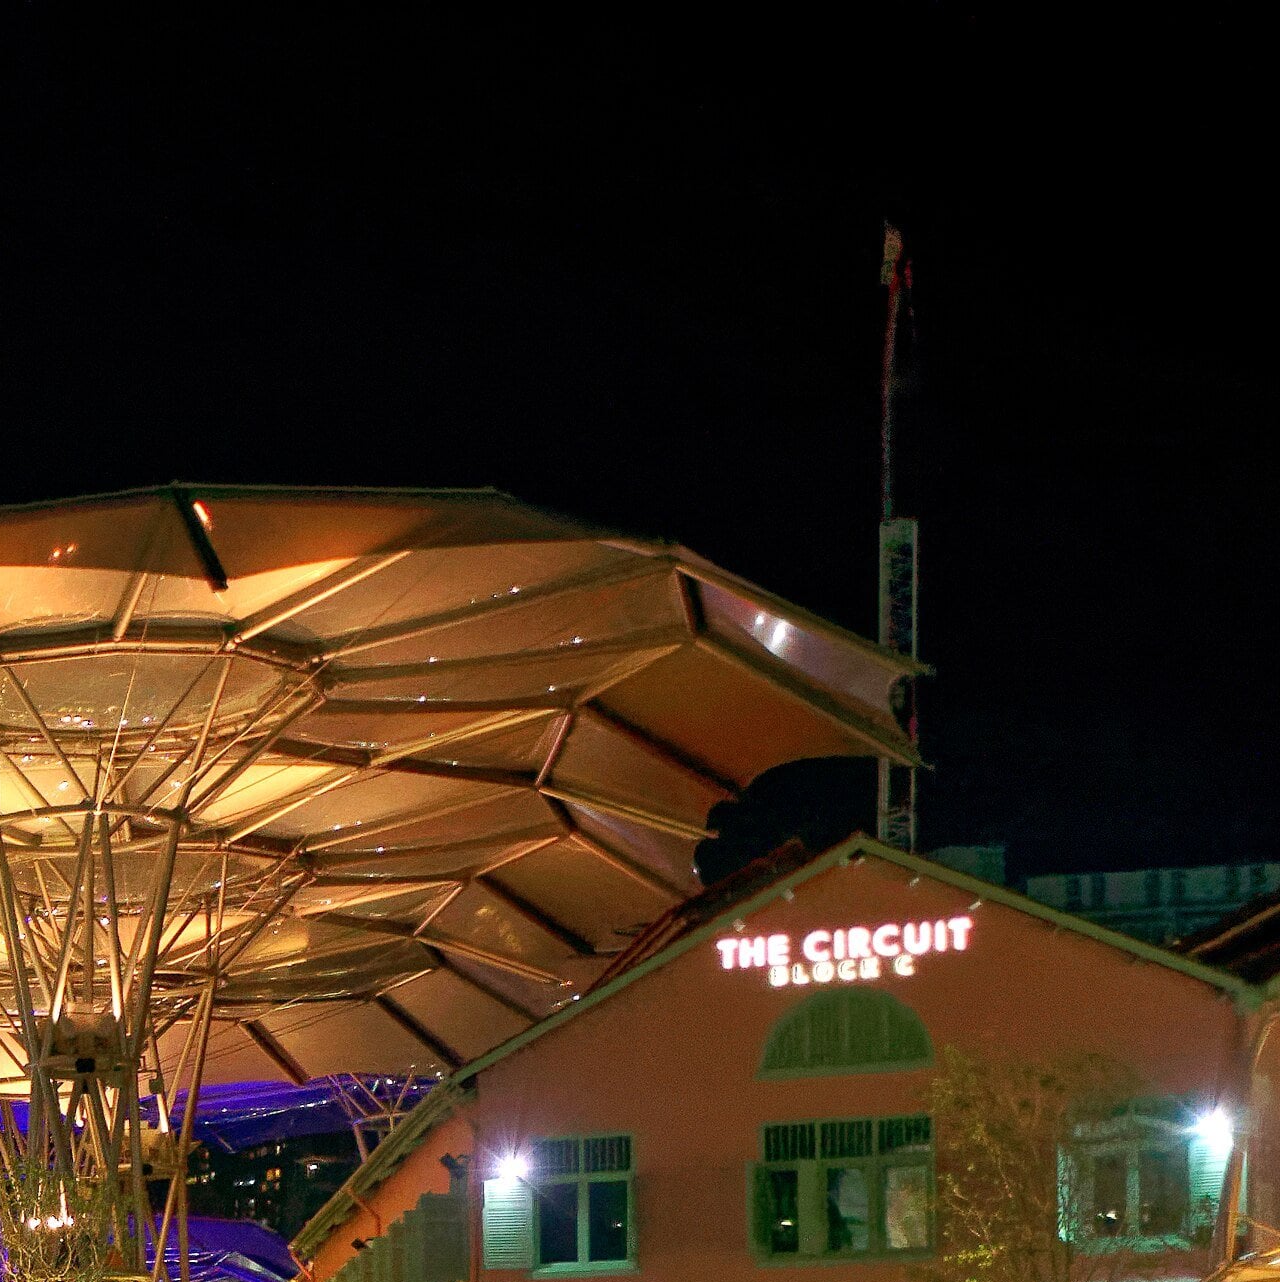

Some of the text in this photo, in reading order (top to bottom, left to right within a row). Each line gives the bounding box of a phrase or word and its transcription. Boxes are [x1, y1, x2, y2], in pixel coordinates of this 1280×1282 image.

[716, 916, 973, 969] THE CIRCUIT
[770, 955, 914, 987] BLOCK C
